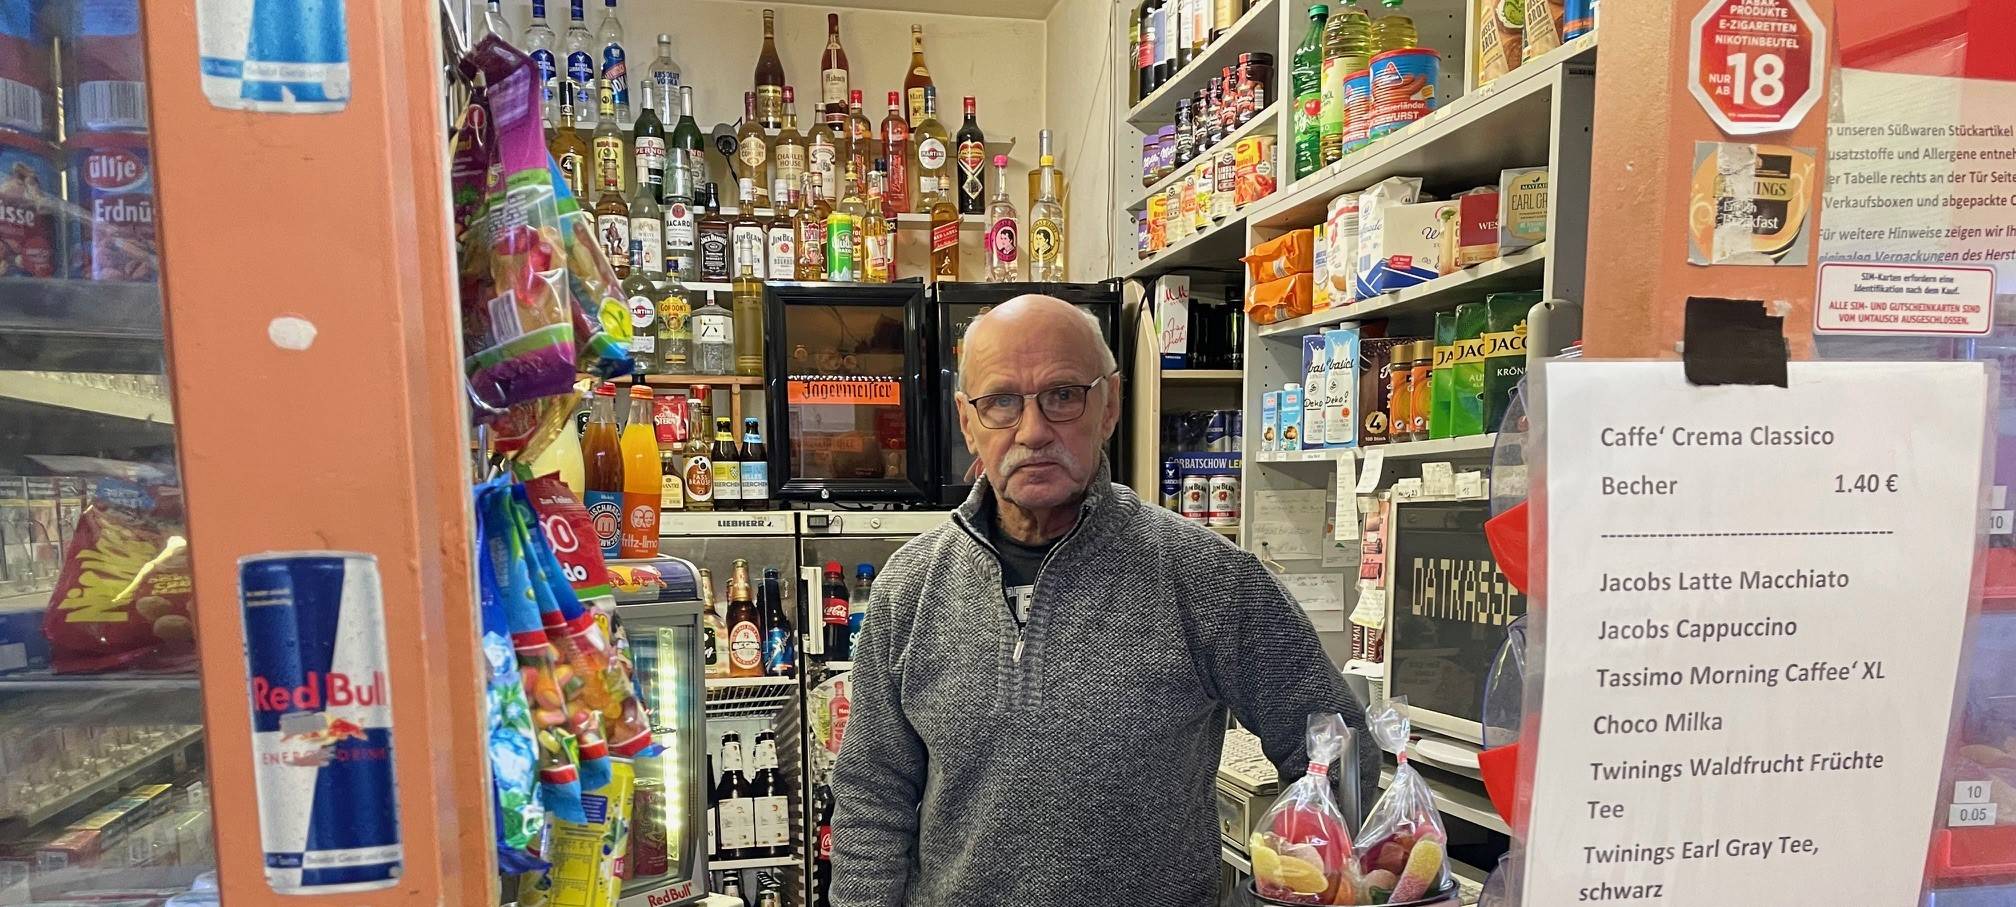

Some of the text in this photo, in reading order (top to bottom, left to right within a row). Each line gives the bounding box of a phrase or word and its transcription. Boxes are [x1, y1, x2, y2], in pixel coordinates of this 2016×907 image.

[1730, 5, 1788, 18] PRODUKTE
[1719, 19, 1797, 33] E-ZIGARETTEN
[1715, 34, 1799, 48] NIKOTINBEUTEL
[654, 71, 680, 80] ABSOLUT
[1708, 74, 1731, 84] NUR
[1727, 52, 1784, 106] 18
[1715, 86, 1731, 95] AB
[1836, 123, 2014, 137] unseren Süßwaren Stückartikel
[1897, 149, 1920, 160] und
[1923, 148, 1976, 162] Allergene
[88, 155, 137, 181] ültje
[1844, 171, 1887, 185] Tabelle
[1890, 171, 1927, 184] rechts
[1929, 174, 1944, 184] an
[1947, 171, 1966, 183] der
[1969, 170, 1988, 183] Tür
[1511, 193, 1534, 210] EARL
[1824, 194, 2007, 210] Verkaufsboxen und abgepackte
[1839, 228, 1885, 240] weitere
[1888, 226, 1942, 240] Hinweise
[1945, 225, 1982, 241] zeigen
[1985, 225, 2004, 237] wir
[1962, 249, 1981, 261] des
[1829, 301, 1848, 310] ALLE
[1870, 302, 1887, 311] UND
[1839, 313, 1856, 322] VOM
[1858, 314, 1899, 323] UMTAUSCH
[802, 381, 892, 399] Jägermeister
[1369, 414, 1380, 430] 4
[1672, 426, 1743, 447] Crema
[1750, 425, 1835, 447] Classico
[1601, 473, 1899, 496] Becher 1.40 €
[717, 519, 765, 527] LIEBHERR
[1989, 516, 2004, 529] 10
[1599, 569, 1849, 592] Jacobs Latte Macchiato
[1598, 616, 1798, 642] Jacobs Cappuccino
[1596, 666, 1683, 688] Tassimo
[1690, 664, 1778, 687] Morning
[1861, 661, 1886, 680] XL
[253, 670, 387, 711] Red Bull
[1593, 711, 1723, 735] Choco Milka
[1590, 750, 1884, 783] Twinings Waldfrucht Früchte
[1968, 785, 1982, 798] 10
[1587, 800, 1625, 820] Tee
[1960, 808, 1987, 822] 0.05
[1584, 835, 1819, 866] Twinings Earl Gray Tee,
[670, 884, 692, 903] Bull
[1579, 881, 1663, 902] schwarz
